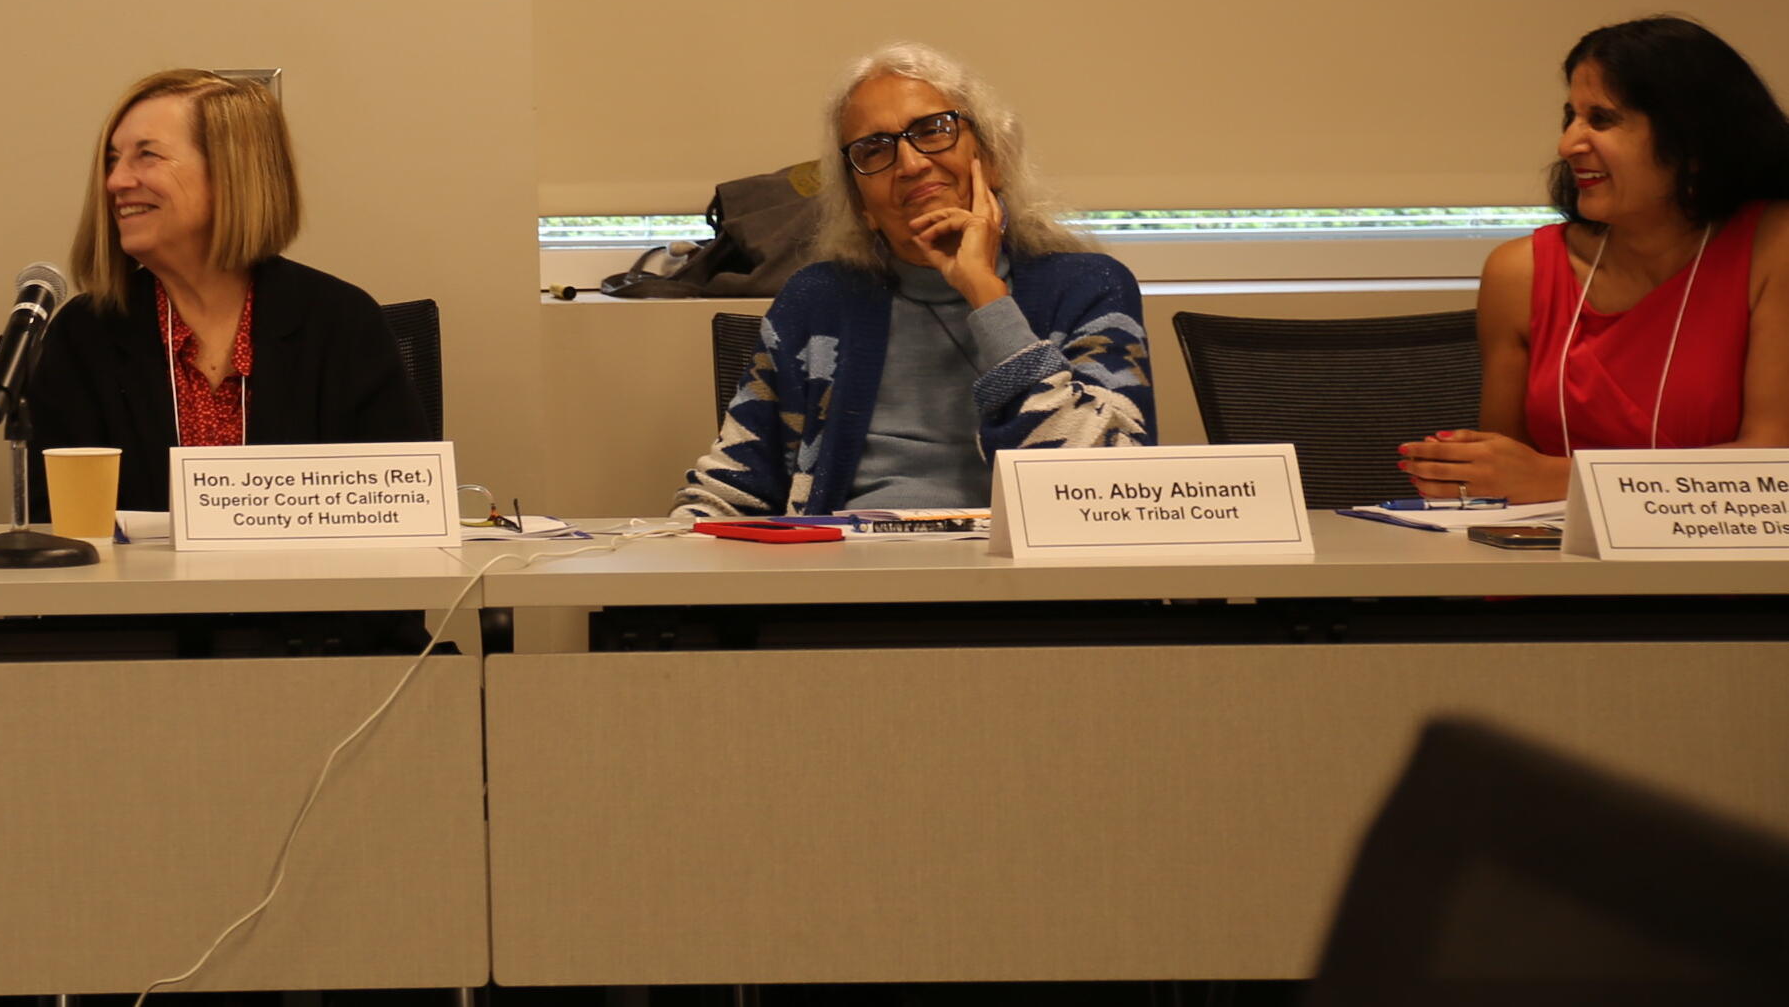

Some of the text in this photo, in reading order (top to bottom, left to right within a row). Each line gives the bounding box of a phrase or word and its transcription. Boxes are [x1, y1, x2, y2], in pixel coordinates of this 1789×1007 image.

[193, 468, 433, 491] Hon. Joyce Hinrichs (Ret.)
[1618, 476, 1789, 494] Hon. Shama Me
[198, 490, 430, 510] Superior Court of California,
[1054, 480, 1256, 503] Hon. Abby Abinanti
[1078, 505, 1240, 522] Yurok Tribal Court
[1643, 500, 1697, 515] Court
[1699, 500, 1718, 515] of
[232, 510, 400, 529] County of Humboldt
[1672, 521, 1758, 539] Appellate
